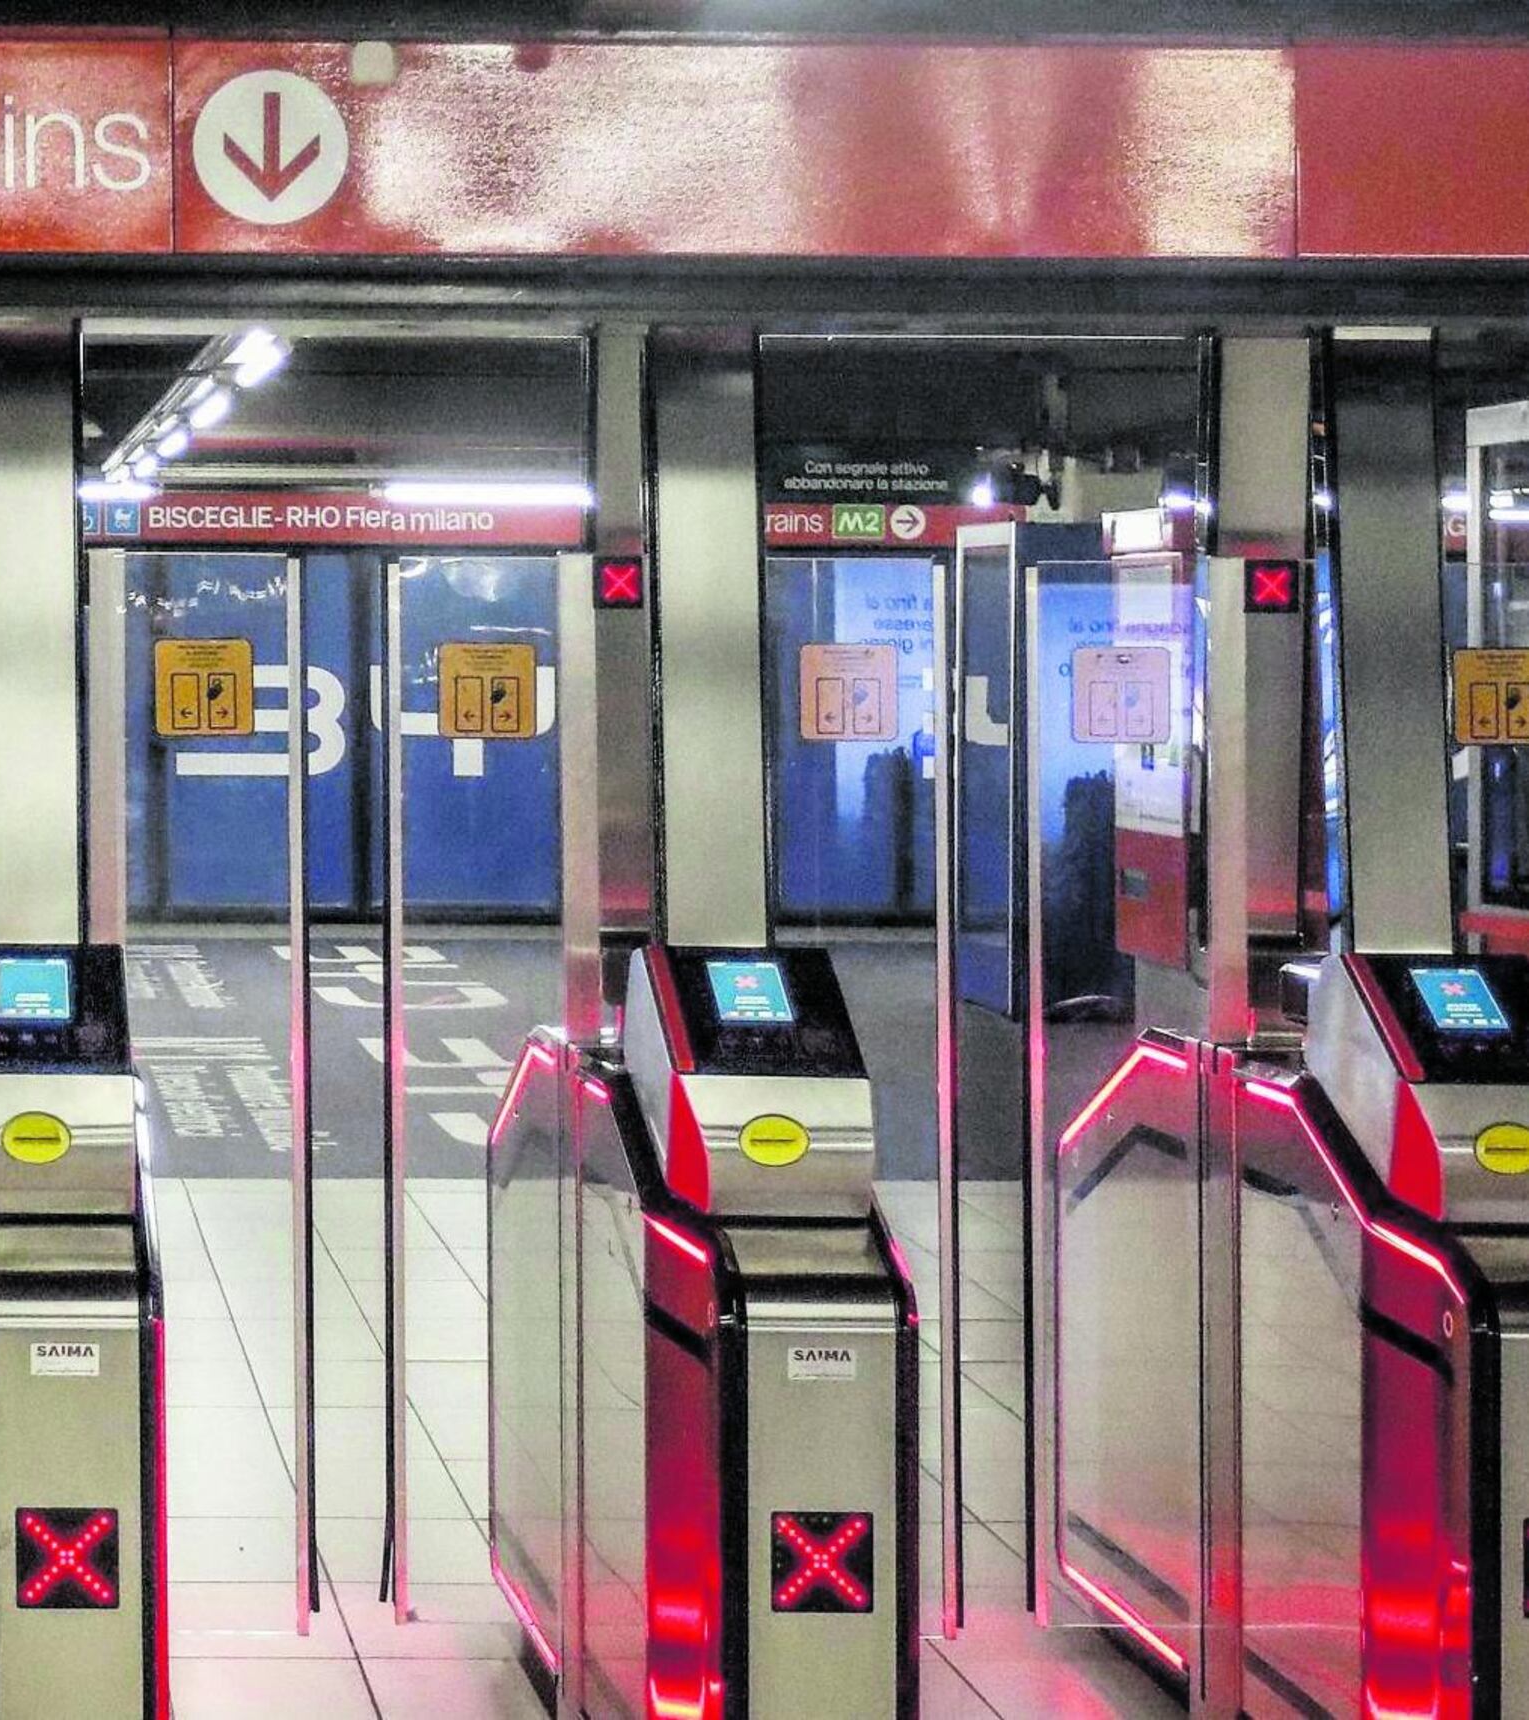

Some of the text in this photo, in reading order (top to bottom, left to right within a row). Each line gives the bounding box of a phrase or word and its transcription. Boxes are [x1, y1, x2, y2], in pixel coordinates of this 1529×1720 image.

[804, 460, 929, 477] Con segnale attivo
[784, 476, 949, 491] abbandonare la stazione
[345, 506, 405, 531] Fiera
[409, 508, 494, 531] milano
[764, 510, 880, 534] rains M2
[36, 1345, 95, 1358] SAIMA
[794, 1349, 852, 1362] SAIMA
